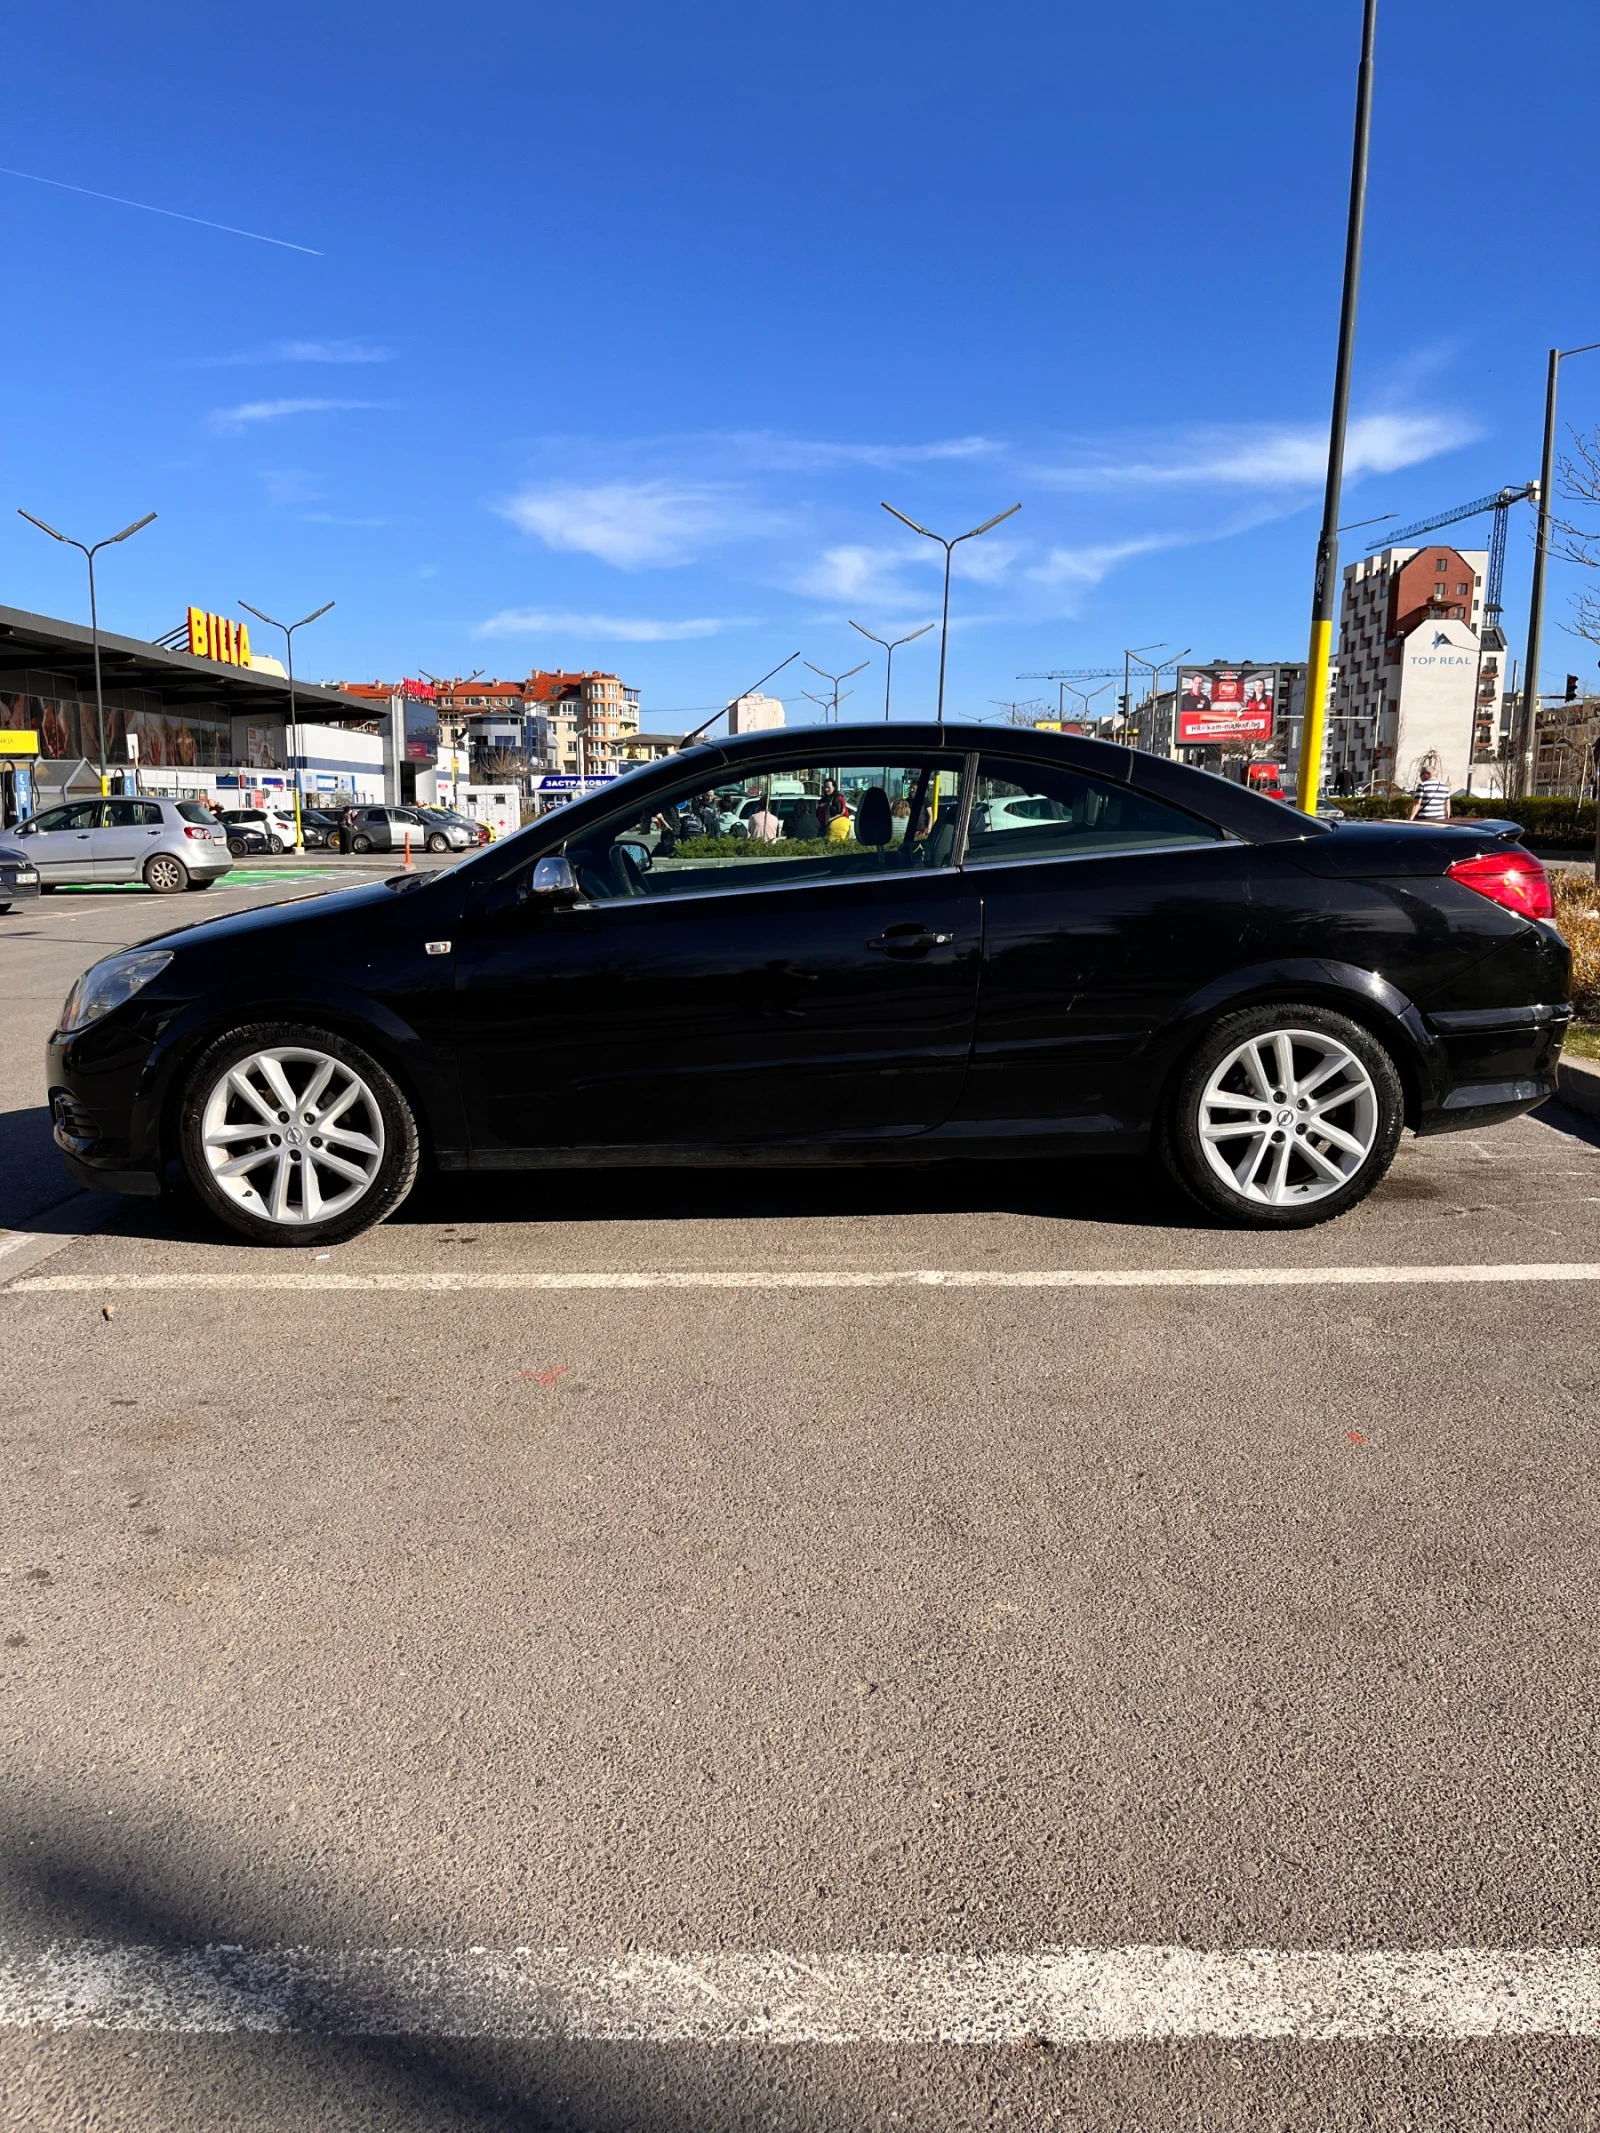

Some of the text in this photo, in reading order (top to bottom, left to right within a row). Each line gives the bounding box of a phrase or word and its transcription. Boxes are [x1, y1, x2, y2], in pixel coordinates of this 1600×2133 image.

[188, 607, 252, 668] BILLA
[1411, 656, 1472, 665] TOP REAL
